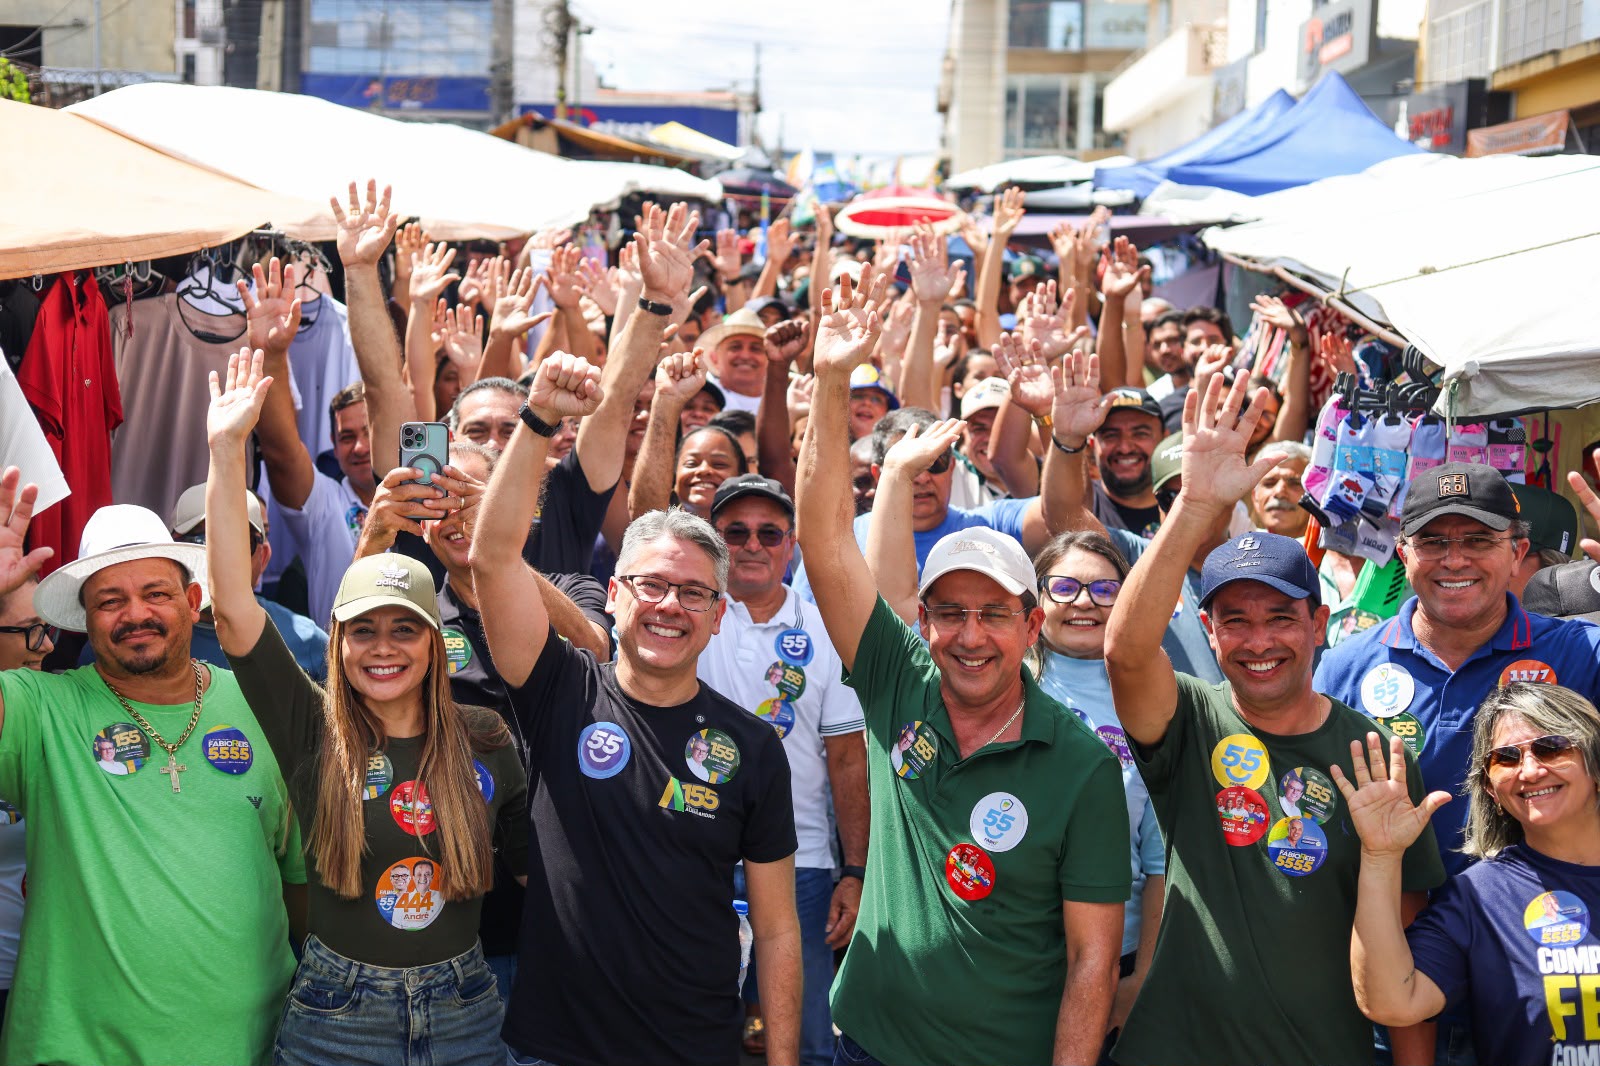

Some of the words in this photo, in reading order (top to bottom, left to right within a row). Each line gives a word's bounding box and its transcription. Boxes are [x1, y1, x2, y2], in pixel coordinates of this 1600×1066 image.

[1361, 537, 1388, 554] SPORT
[376, 577, 411, 590] adidas
[782, 635, 808, 649] 55
[784, 669, 804, 686] 155
[1510, 669, 1550, 682] 1177
[1374, 677, 1400, 701] 55
[1098, 730, 1126, 742] KATARIN
[1390, 721, 1418, 736] 155
[111, 729, 142, 748] 155
[586, 729, 625, 755] 55
[208, 747, 250, 760] 5555
[710, 741, 736, 762] 155
[914, 735, 937, 761] 155
[367, 755, 386, 771] 55
[1220, 744, 1265, 772] 55
[681, 783, 720, 810] 155
[1305, 780, 1332, 803] 155
[982, 808, 1017, 832] 55
[1275, 855, 1314, 873] 5555
[379, 897, 395, 906] 55
[394, 892, 435, 913] 444
[404, 912, 430, 921] André
[1541, 929, 1582, 944] 5555
[1537, 945, 1600, 974] COMP
[1543, 974, 1600, 1041] FE
[1552, 1042, 1600, 1066] COM
